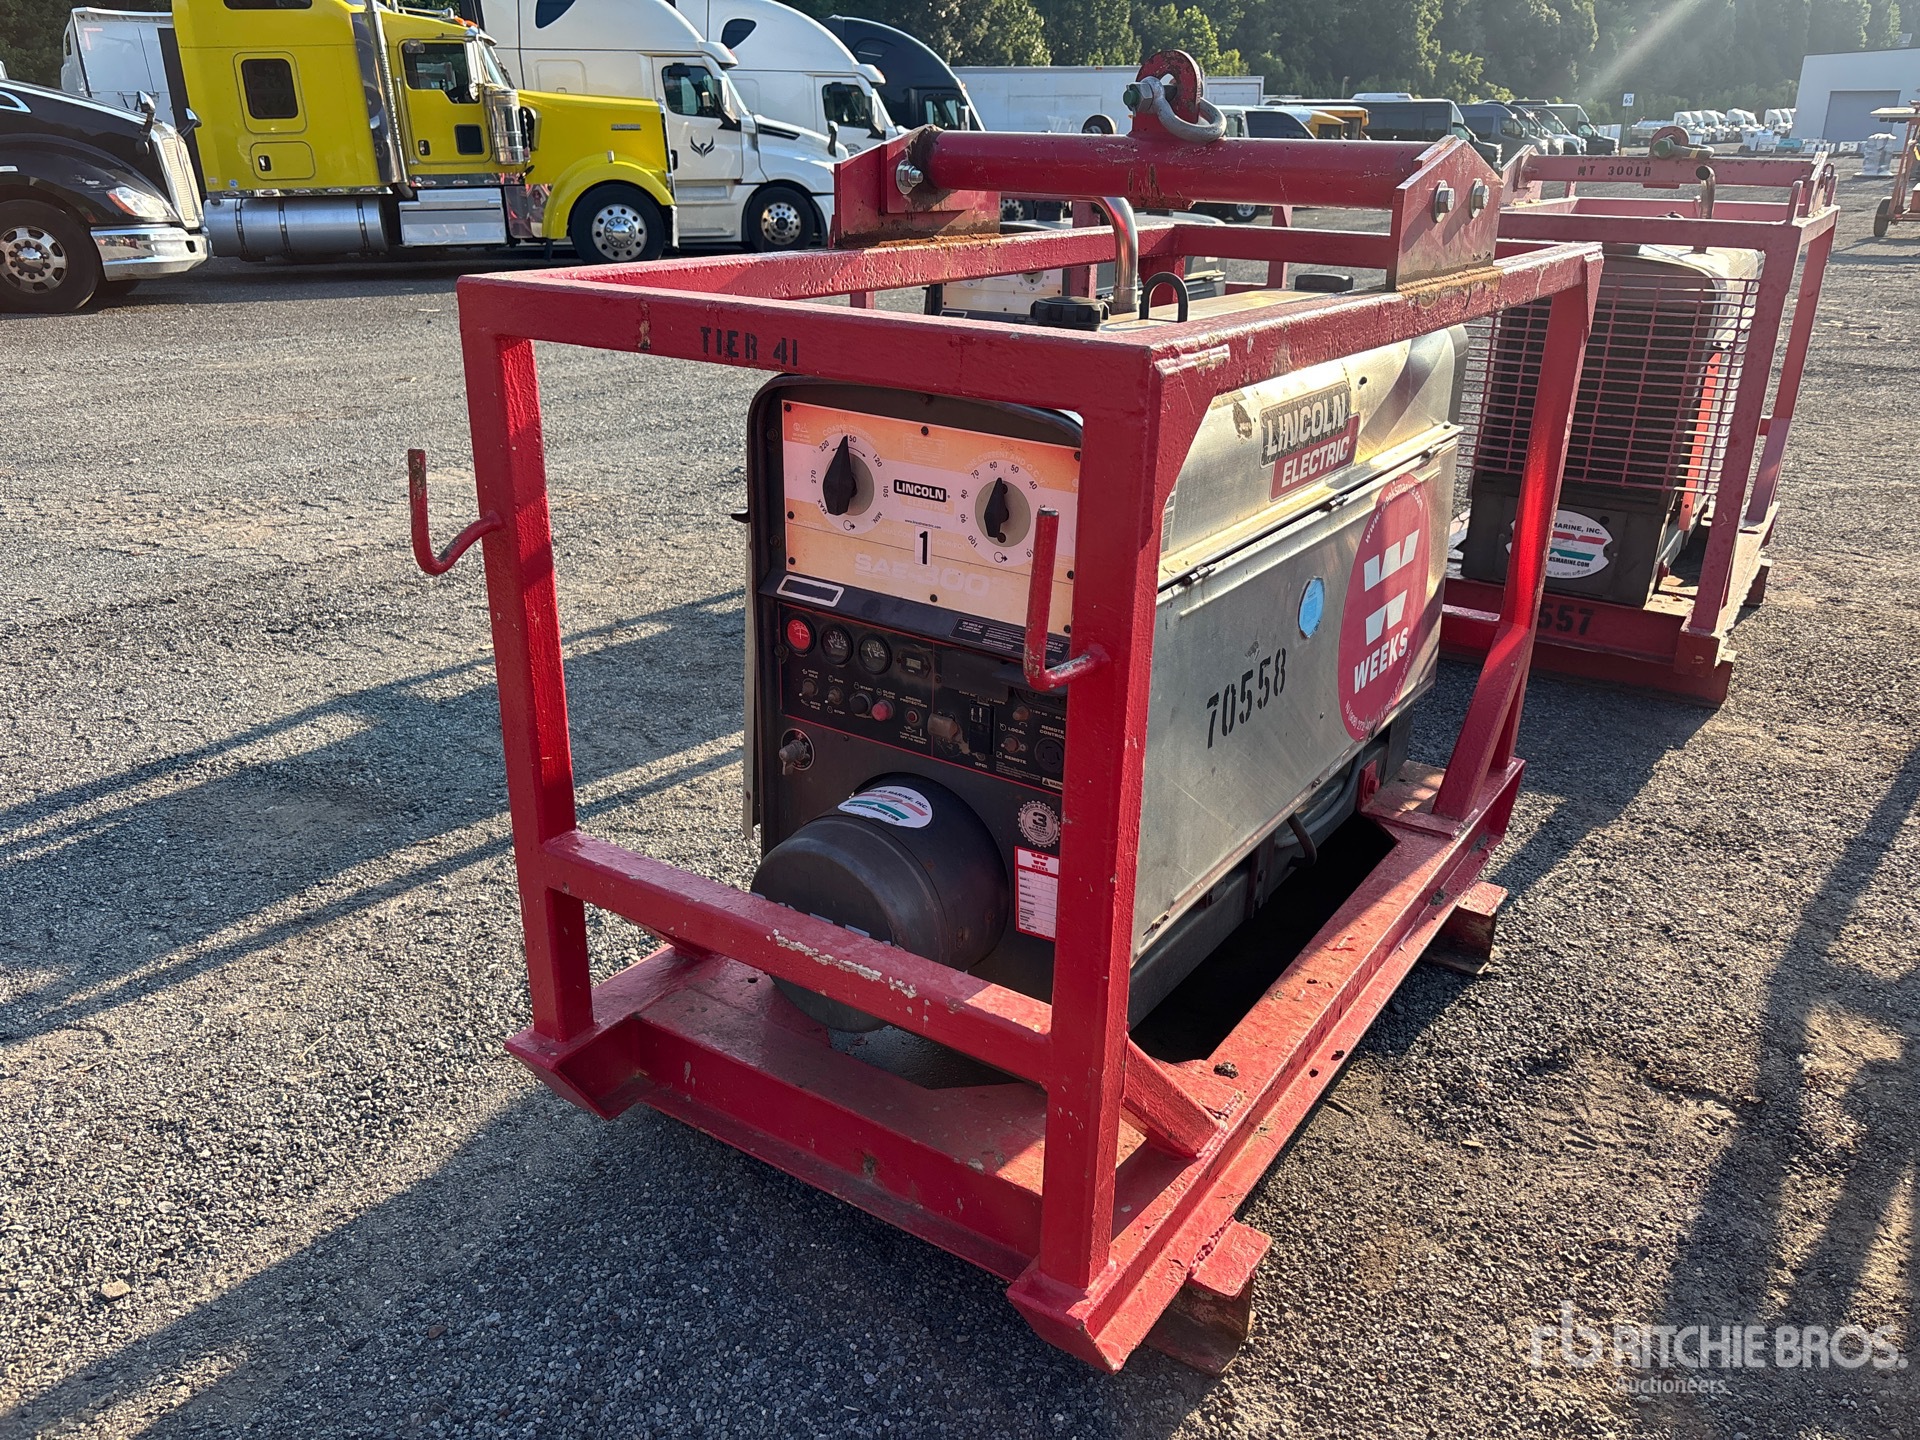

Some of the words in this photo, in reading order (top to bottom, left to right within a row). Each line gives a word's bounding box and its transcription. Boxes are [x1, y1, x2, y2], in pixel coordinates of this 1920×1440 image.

[1608, 166, 1651, 177] 300LB
[701, 326, 758, 360] TIER
[773, 337, 797, 366] 41
[1267, 392, 1346, 457] LINCOLN
[818, 440, 830, 452] 220
[872, 453, 883, 468] 120
[989, 461, 998, 470] 60
[1281, 435, 1350, 488] ELECTRIC
[970, 469, 980, 479] 70
[1010, 464, 1020, 474] 50
[896, 481, 944, 501] LINCOLN
[1028, 480, 1038, 490] 40
[960, 489, 968, 500] 80
[817, 498, 828, 515] MAX
[872, 511, 883, 524] MIN
[1586, 527, 1603, 535] INC.
[919, 530, 928, 565] 1
[967, 535, 978, 548] 100
[1549, 556, 1590, 568] KSMARINE.COM
[1539, 602, 1594, 636] 557
[1354, 626, 1409, 694] WEEKS
[1206, 647, 1287, 749] 70558
[1007, 726, 1026, 736] LOCAL
[1041, 724, 1064, 735] REMOTE
[1004, 754, 1027, 765] REMOTE
[914, 800, 929, 811] INC.
[1032, 811, 1048, 828] 3
